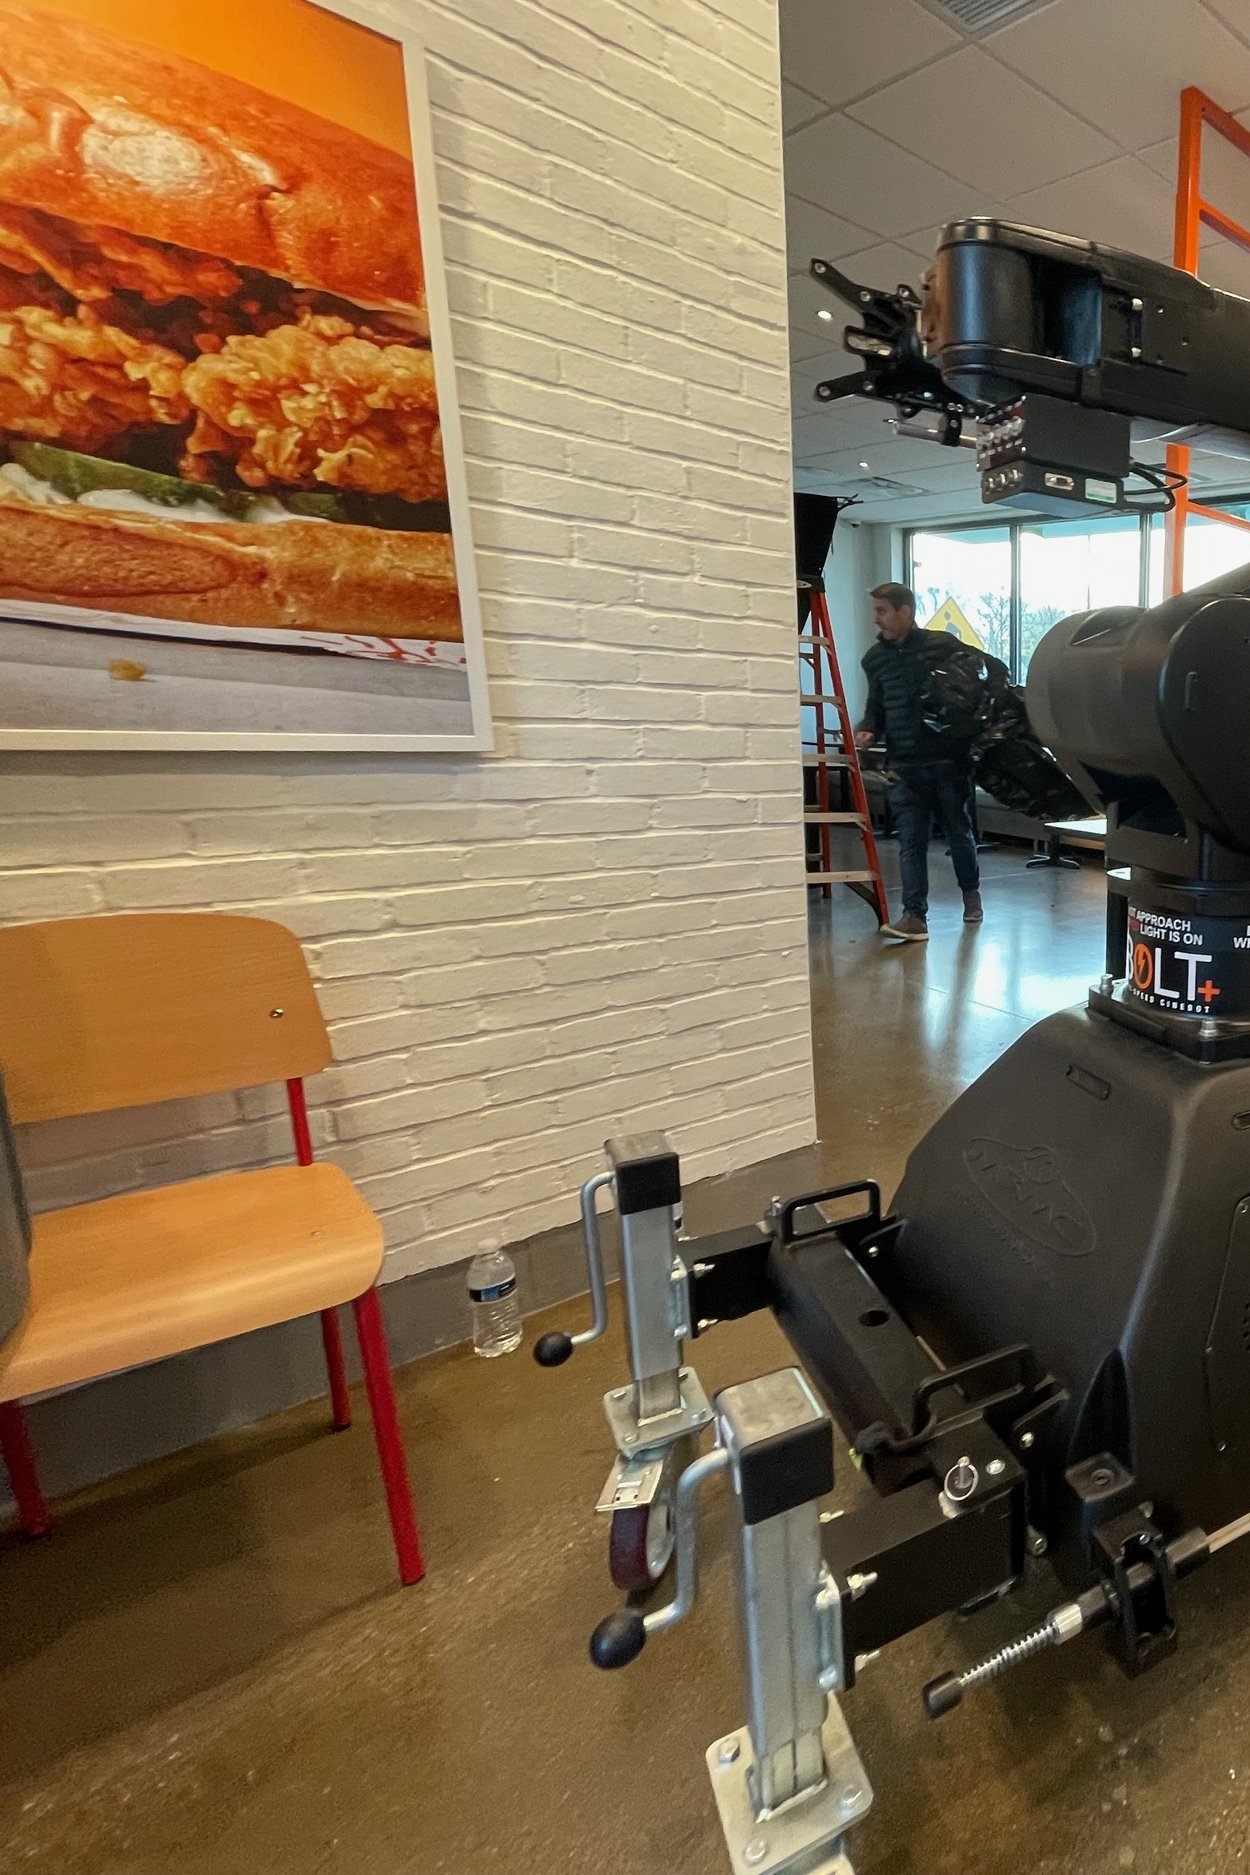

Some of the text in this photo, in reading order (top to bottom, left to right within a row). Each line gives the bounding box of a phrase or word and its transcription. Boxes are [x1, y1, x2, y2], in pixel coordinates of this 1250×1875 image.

[1136, 910, 1191, 932] APPROACH
[1140, 923, 1167, 940] LIGHT
[1169, 931, 1181, 943] IS
[1183, 934, 1203, 946] ON
[1160, 998, 1210, 1014] CINEBOT
